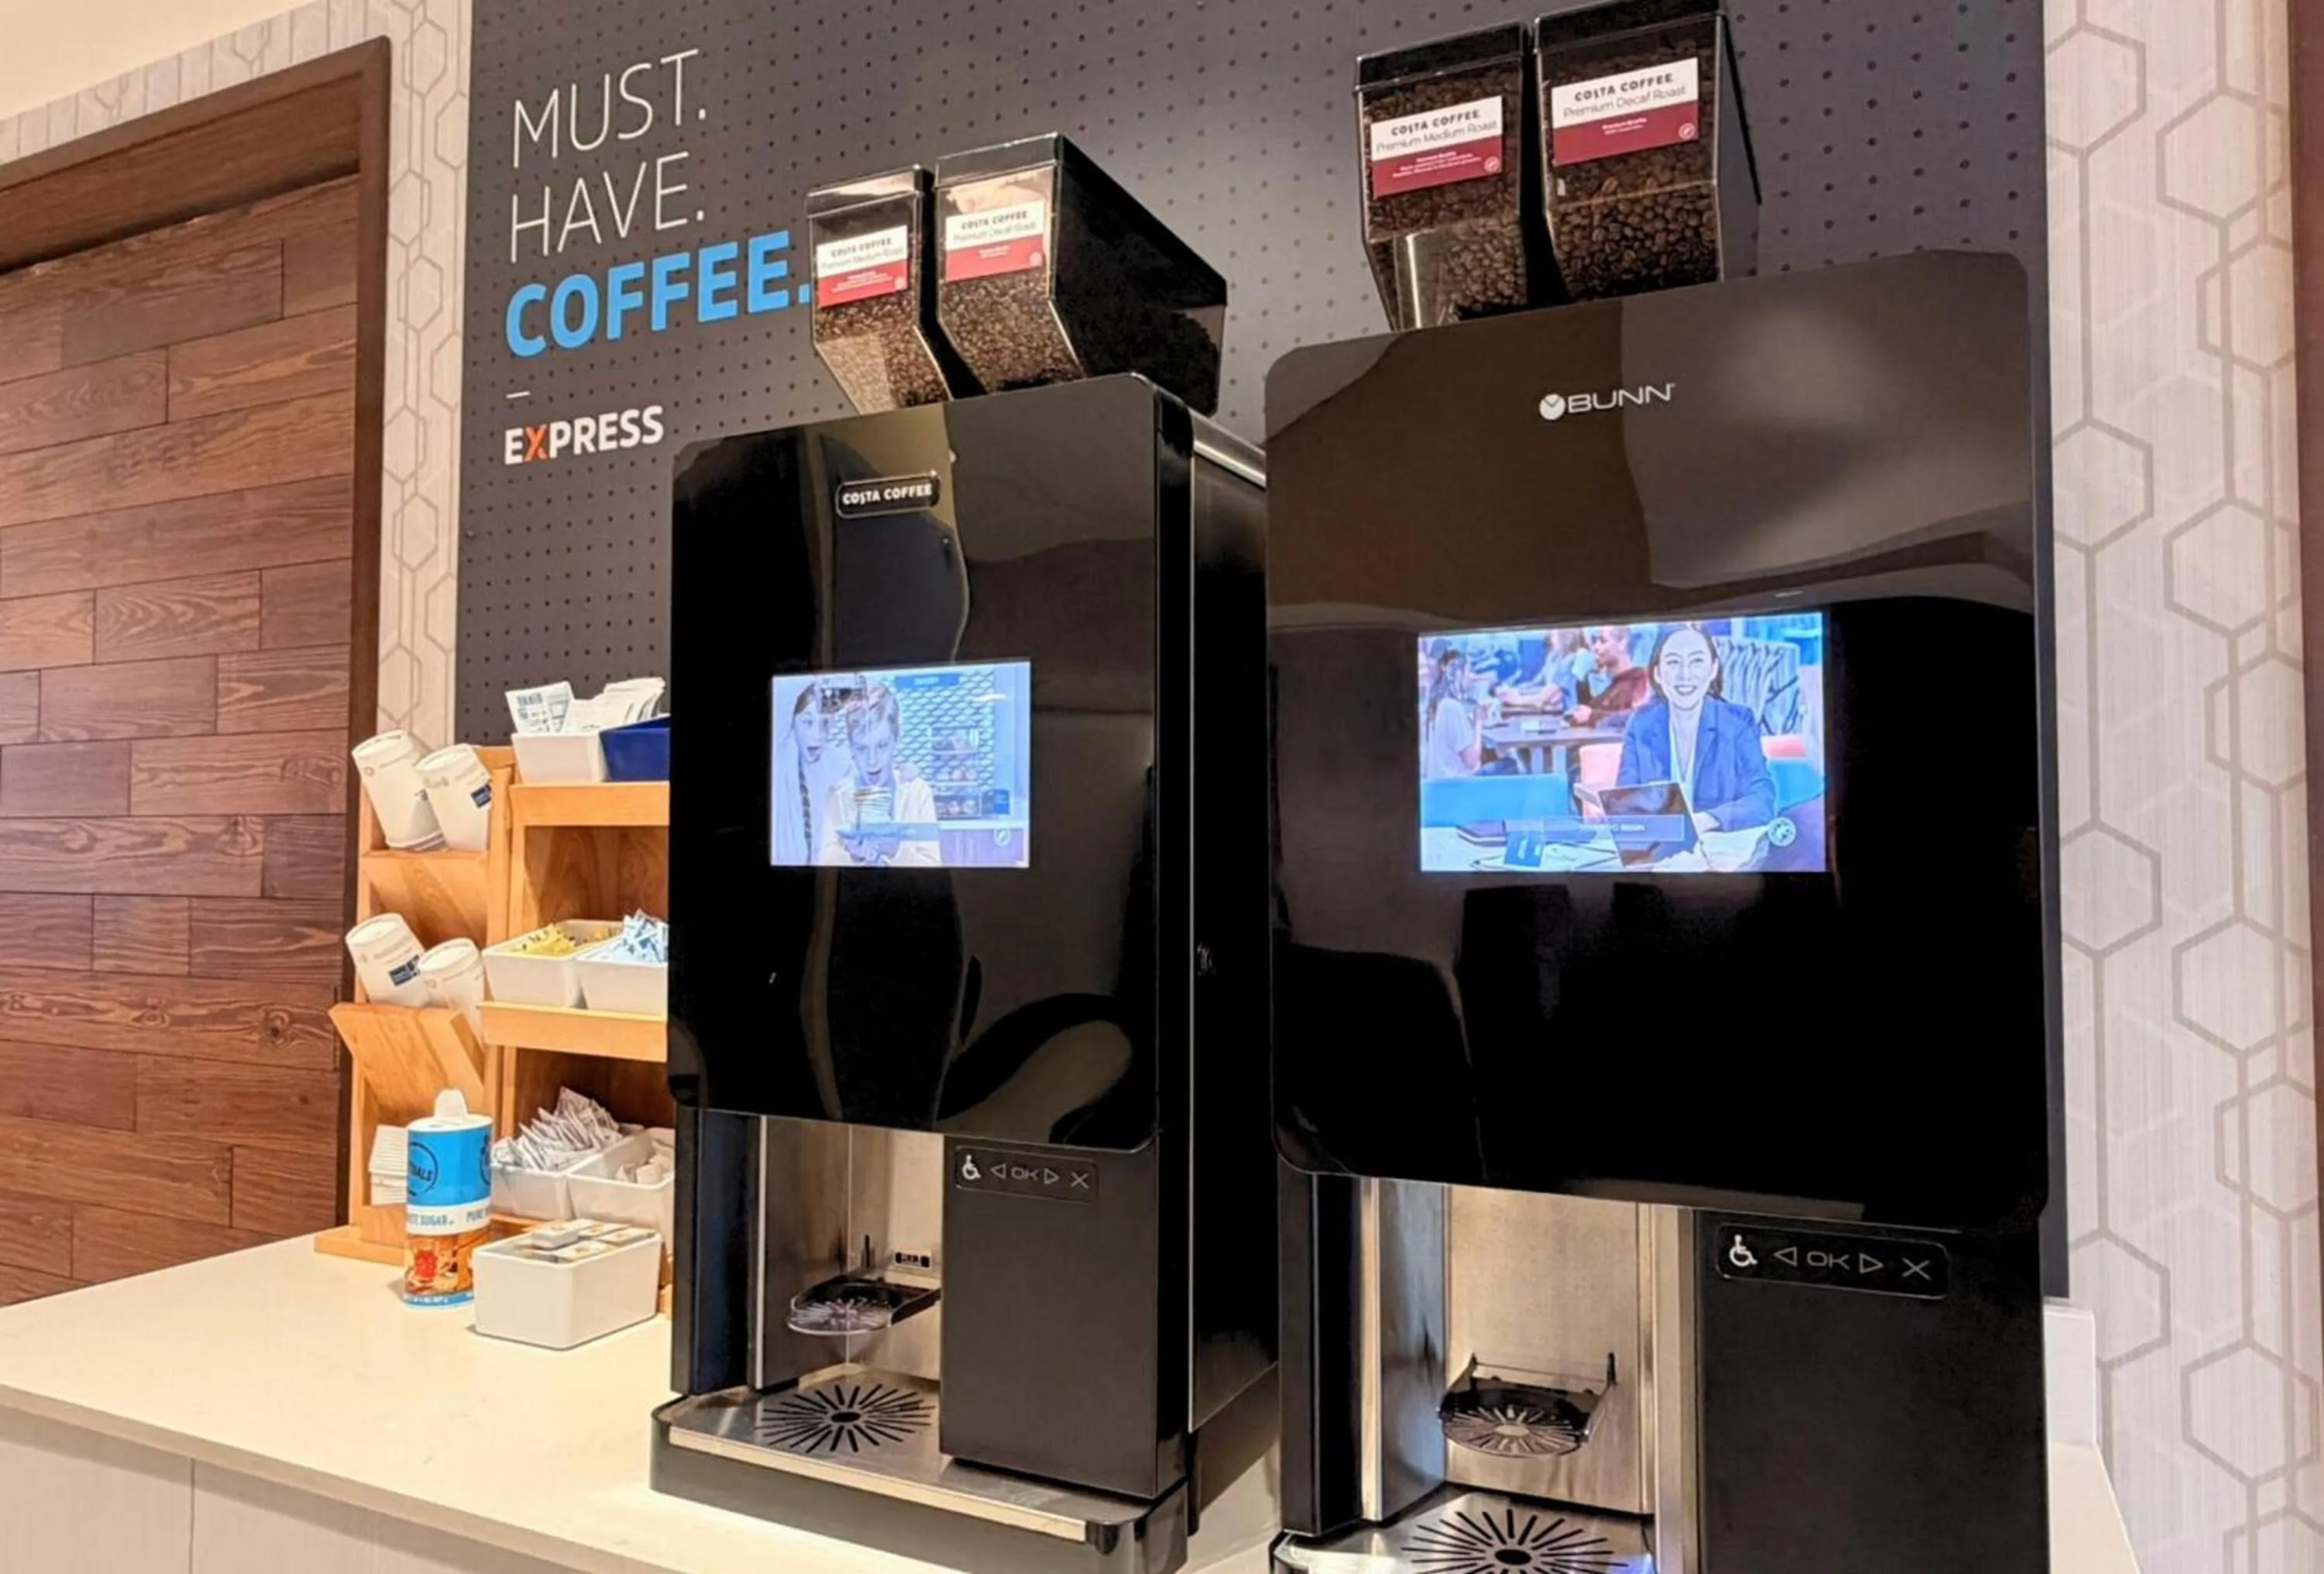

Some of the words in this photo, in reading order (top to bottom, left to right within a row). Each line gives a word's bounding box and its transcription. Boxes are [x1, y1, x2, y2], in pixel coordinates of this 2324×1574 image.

[1563, 101, 1615, 119] Premium
[1616, 92, 1651, 109] Decaf
[1653, 85, 1686, 100] Roast
[1574, 86, 1615, 102] COSTA
[1620, 73, 1673, 93] COFFEE
[514, 49, 706, 168] MUST.
[1391, 120, 1428, 136] COSTA
[1432, 109, 1480, 128] COFFEE
[1376, 136, 1422, 153] Premium
[1423, 126, 1466, 143] Medium
[511, 151, 704, 264] HAVE.
[961, 218, 989, 231] COSTA
[992, 210, 1029, 225] COFFEE
[506, 230, 810, 356] COFFEE.
[1567, 383, 1672, 414] BUNN
[504, 405, 664, 465] EXPRESS
[842, 490, 881, 505] COSTA
[883, 483, 932, 500] COFFEE
[1010, 1167, 1039, 1181] OK
[1807, 1251, 1850, 1270] OK
